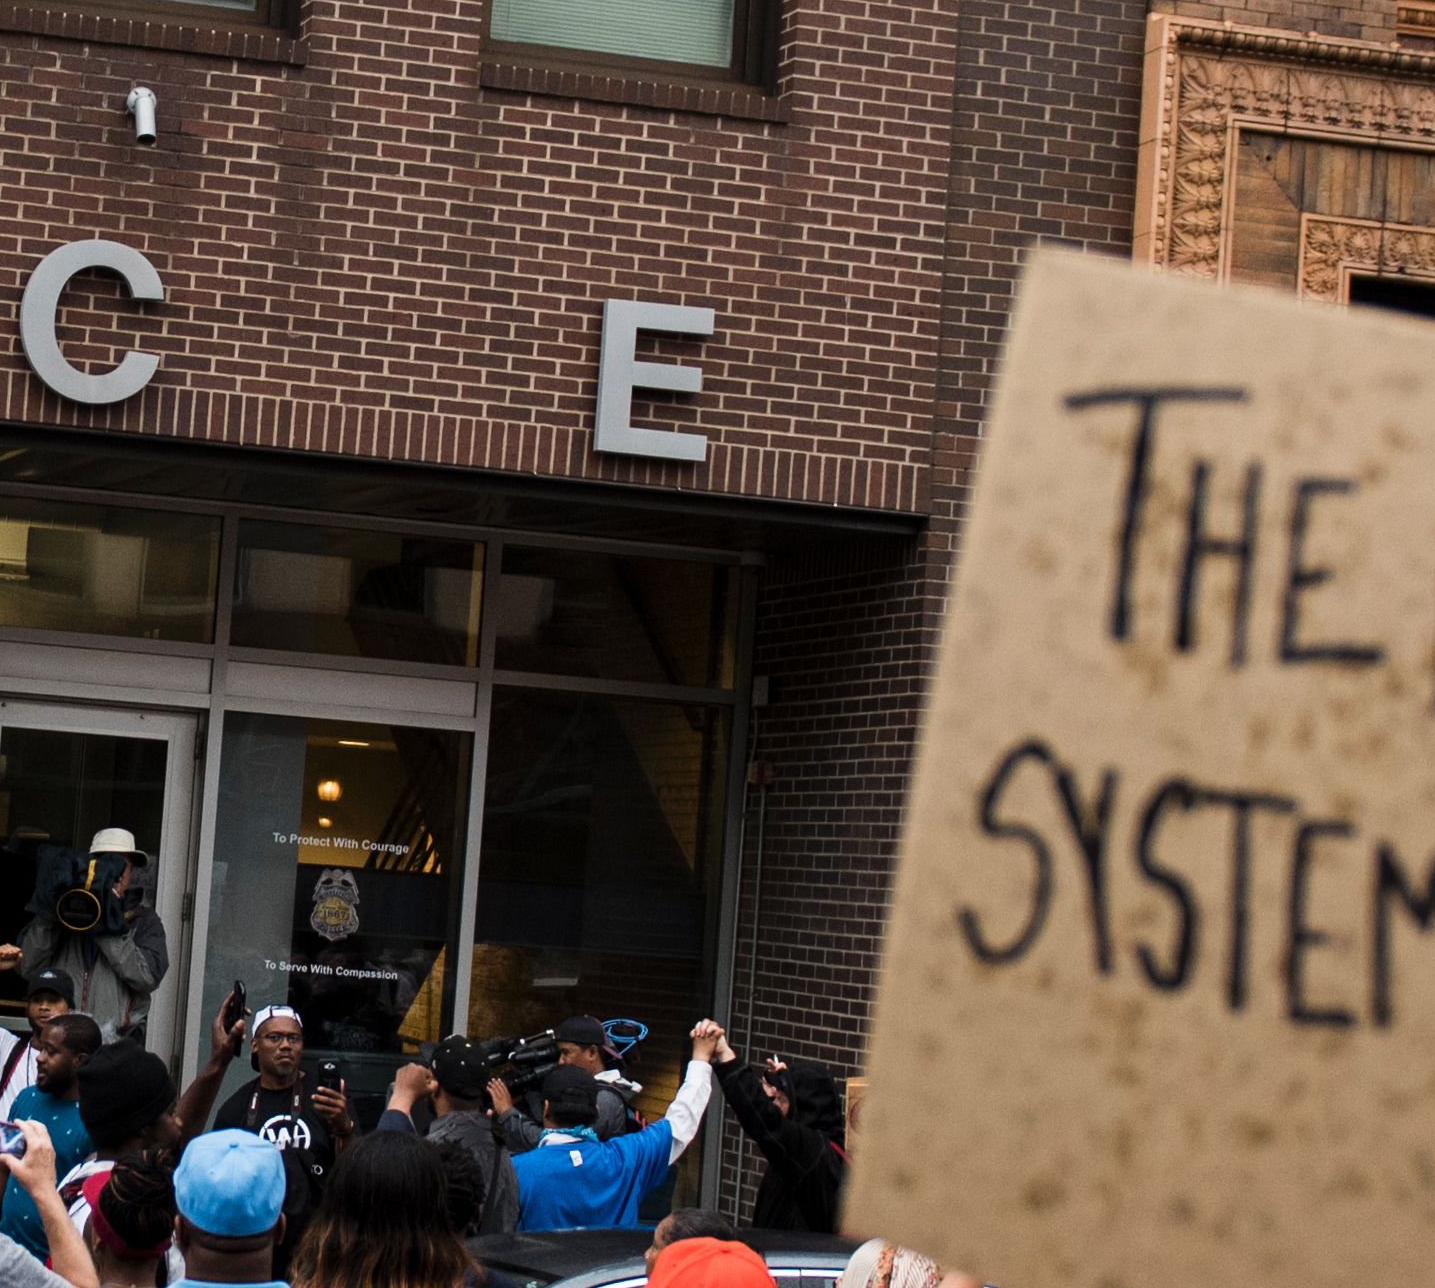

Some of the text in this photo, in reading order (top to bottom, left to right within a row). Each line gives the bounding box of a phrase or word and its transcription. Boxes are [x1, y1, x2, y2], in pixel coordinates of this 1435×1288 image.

[1060, 385, 1386, 671] THE
[272, 831, 410, 856] To Protect With Courage
[263, 959, 398, 981] To Serve With Compassion
